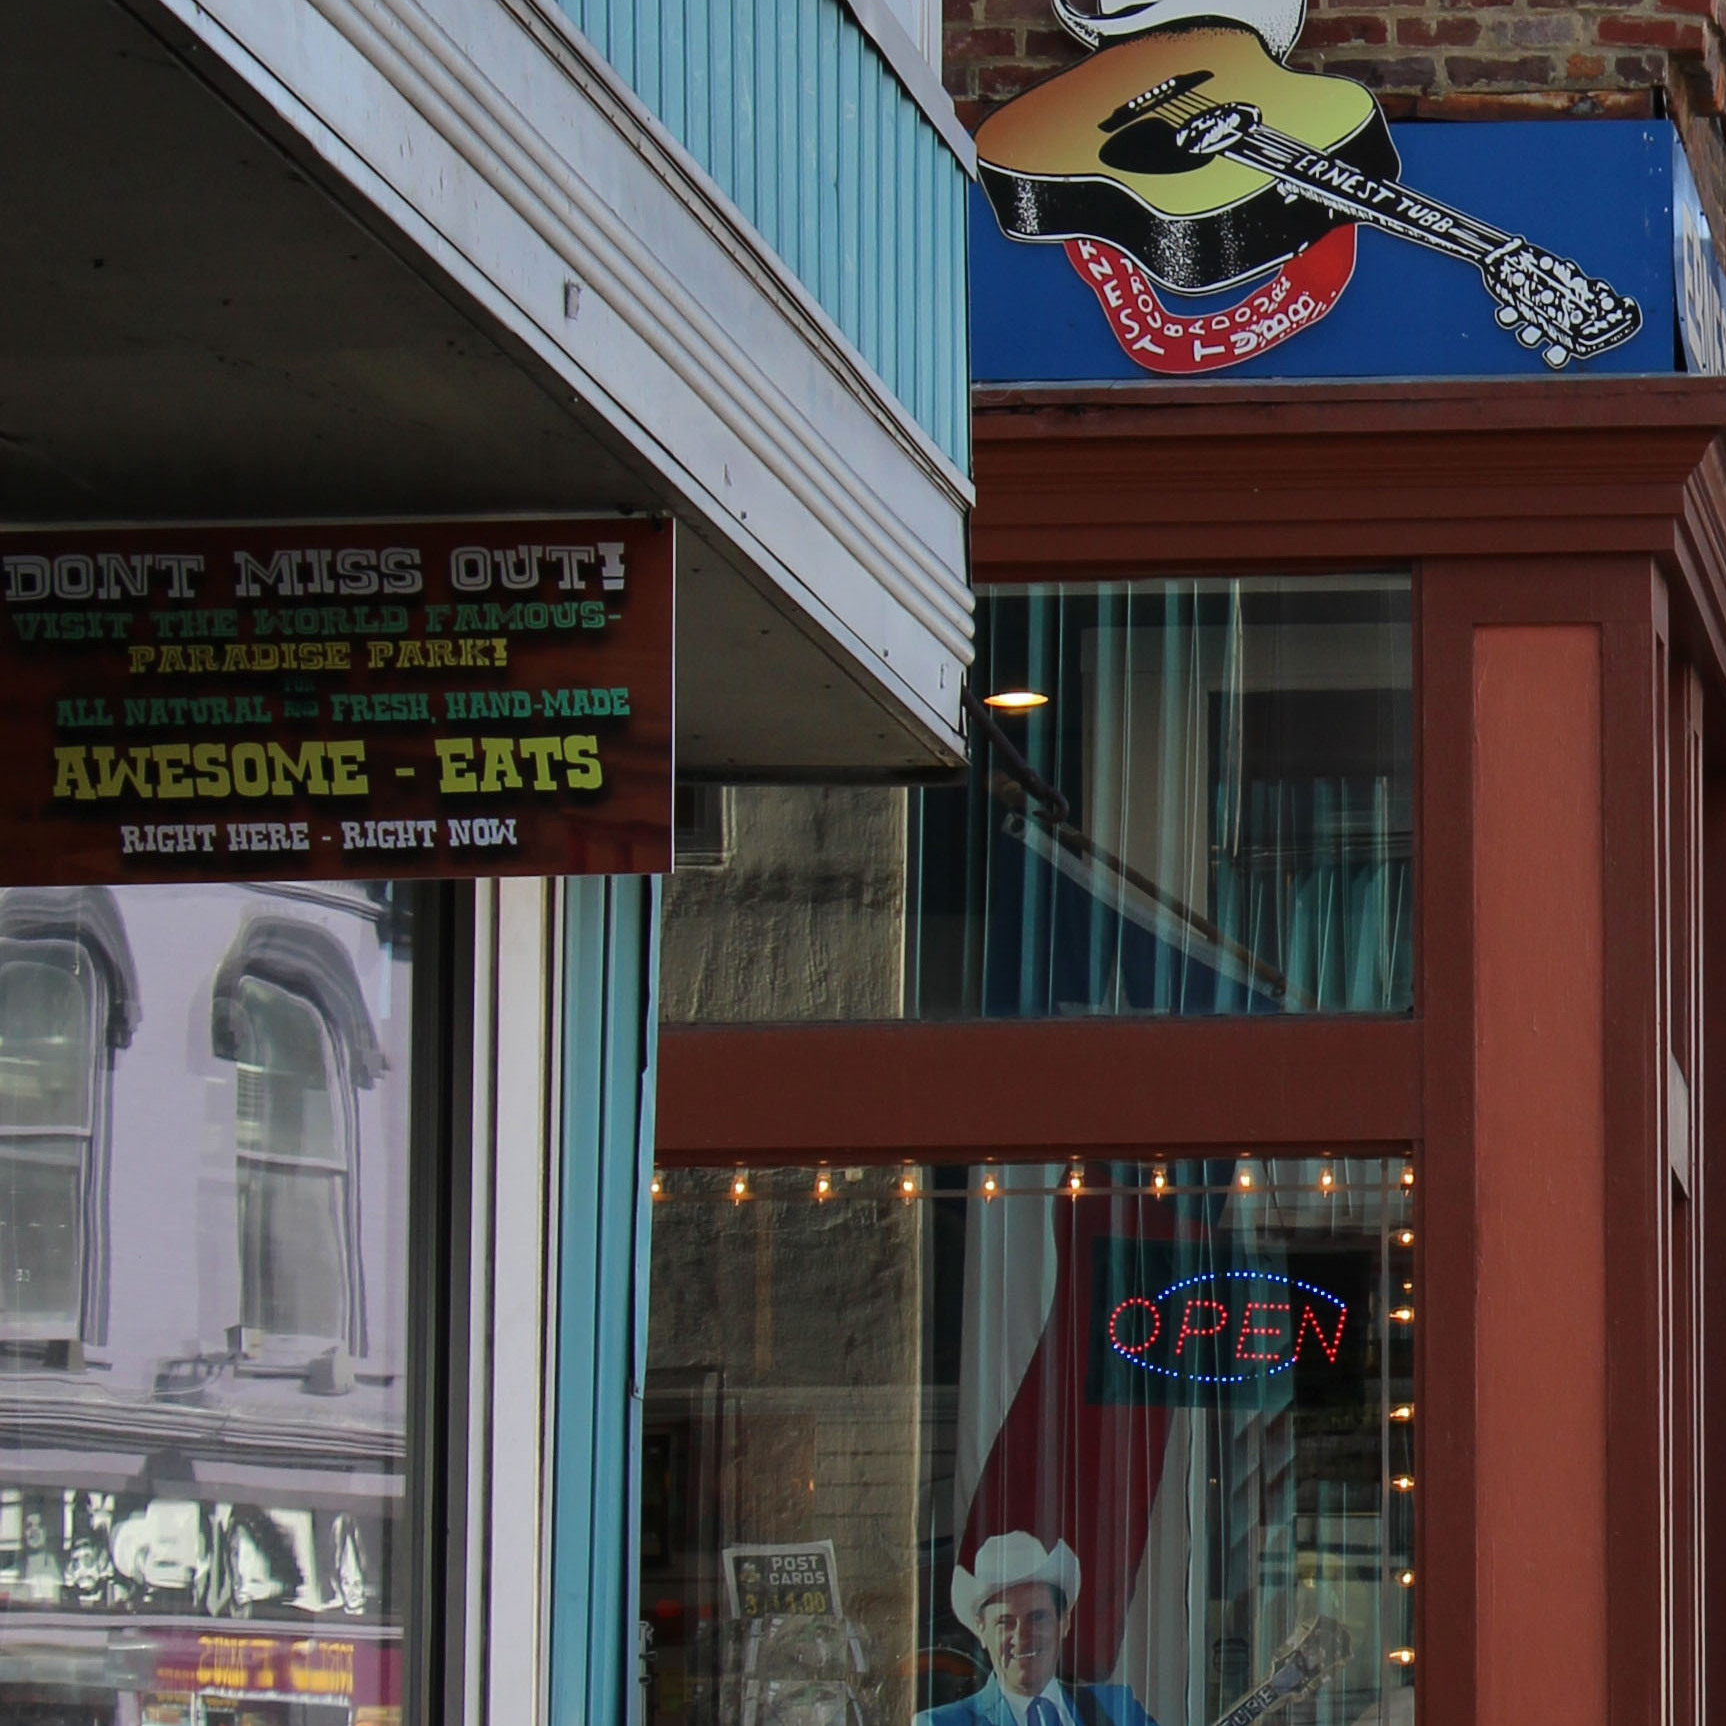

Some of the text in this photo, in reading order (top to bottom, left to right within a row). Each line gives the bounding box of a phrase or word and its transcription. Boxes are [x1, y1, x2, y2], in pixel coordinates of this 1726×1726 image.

[1294, 154, 1454, 233] ERNEST TUBB
[1194, 296, 1317, 362] TUBB
[3, 542, 625, 602] DONT MISS OUT!
[12, 611, 133, 641] VISIT
[150, 608, 238, 638] THE
[253, 604, 411, 636] WORLD
[128, 638, 508, 673] PARADISE PARK!
[56, 699, 113, 727] ALL
[124, 696, 273, 724] NATURAL
[445, 687, 631, 720] HAND-MADE
[53, 740, 369, 799] AWESOME
[435, 735, 603, 794] EATS
[121, 823, 217, 854] RIGHT
[227, 822, 310, 851] HERE
[341, 820, 436, 850] RIGHT
[448, 817, 518, 846] NOW
[1109, 1298, 1348, 1363] OPEN
[769, 1572, 826, 1586] CARDS
[771, 1556, 819, 1571] POST
